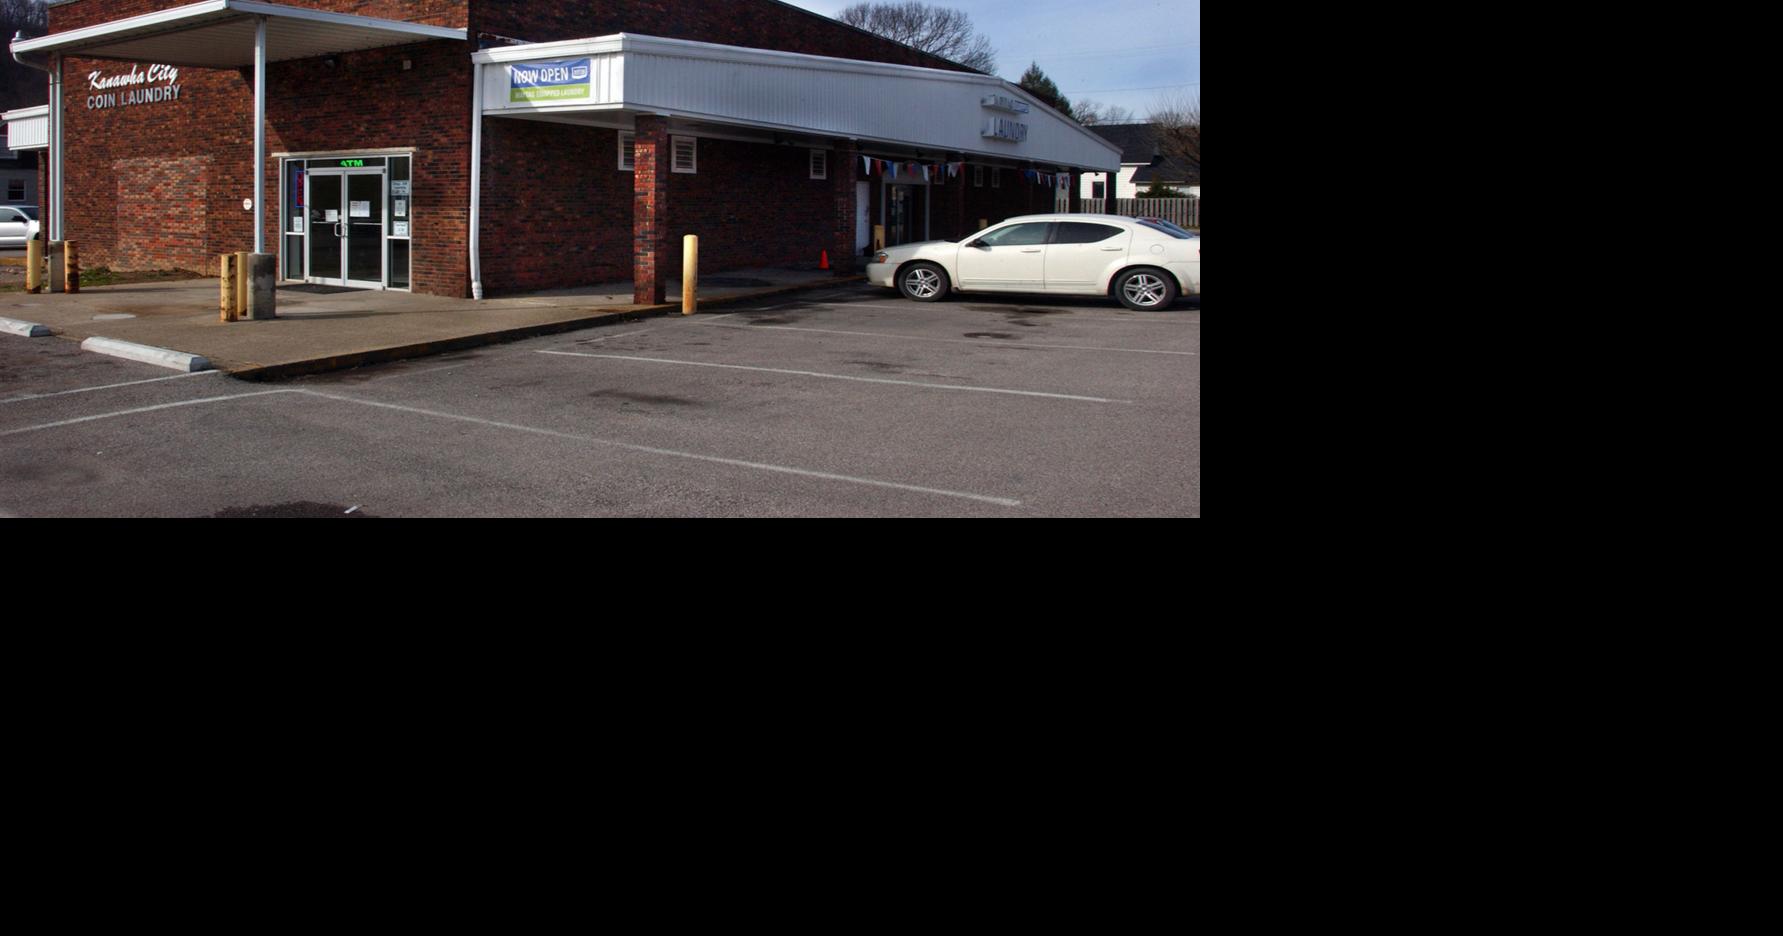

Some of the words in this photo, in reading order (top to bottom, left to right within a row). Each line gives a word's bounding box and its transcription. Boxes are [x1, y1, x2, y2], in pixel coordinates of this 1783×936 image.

[87, 64, 145, 91] Kanawha
[147, 63, 179, 86] City
[513, 69, 539, 84] NOW
[540, 66, 569, 82] OPEN
[87, 93, 116, 110] COIN
[121, 84, 181, 106] LAUNDRY
[340, 159, 364, 168] ATM
